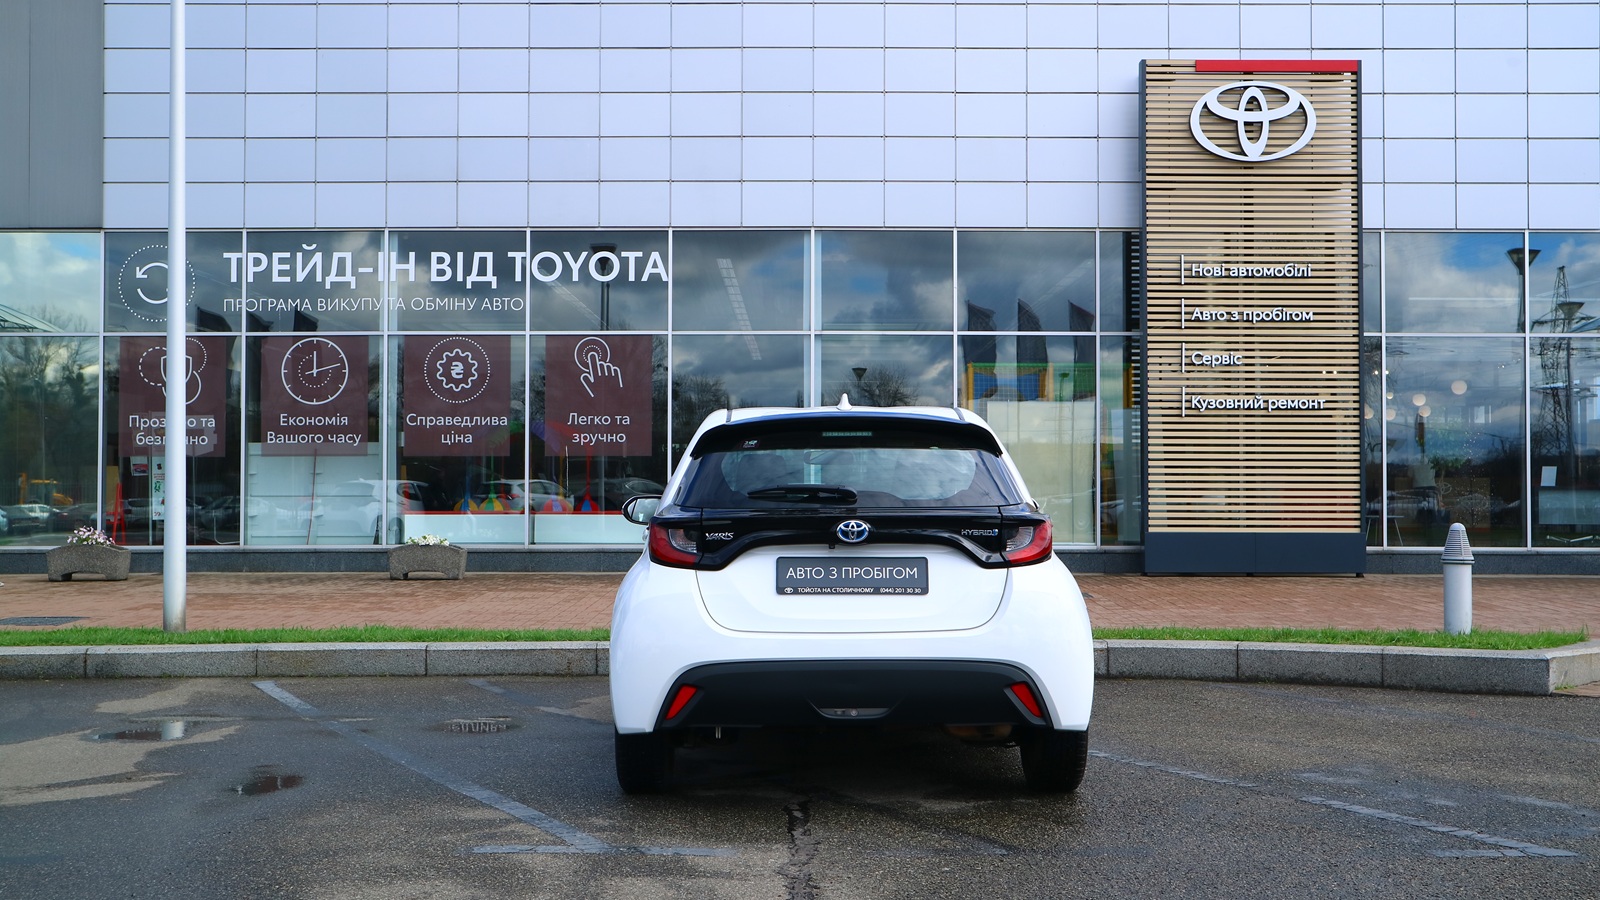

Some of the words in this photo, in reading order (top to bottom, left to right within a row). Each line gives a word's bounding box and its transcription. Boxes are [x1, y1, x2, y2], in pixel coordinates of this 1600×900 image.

[223, 243, 415, 290] ТРЕЙД-ІН
[431, 251, 497, 289] ВІД
[508, 250, 669, 282] TOYOTA
[1191, 263, 1225, 277] Нові
[1229, 262, 1312, 277] автомобілі
[223, 298, 312, 312] ПРОГРАМА
[317, 297, 383, 311] ВИКУПУ
[386, 297, 406, 311] ТА
[411, 297, 477, 311] ОБМІНУ
[481, 297, 524, 311] АВТО
[1191, 307, 1227, 321] Авто
[1230, 311, 1239, 321] з
[1243, 307, 1314, 324] пробігом
[1191, 351, 1243, 368] Сервіс
[1191, 395, 1264, 412] Кузовний
[1268, 398, 1326, 412] ремонт
[129, 415, 197, 430] Прозо
[200, 418, 216, 428] та
[280, 413, 348, 426] Економія
[406, 413, 508, 428] Справедлива
[567, 412, 611, 425] Легко
[615, 415, 630, 425] та
[267, 431, 324, 444] Вашого
[328, 434, 362, 447] часу
[441, 431, 473, 445] ціна
[572, 432, 626, 446] зручно
[705, 532, 735, 541] YARIS
[786, 566, 825, 579] АВТО
[842, 566, 918, 579] ПРОБІГОМ
